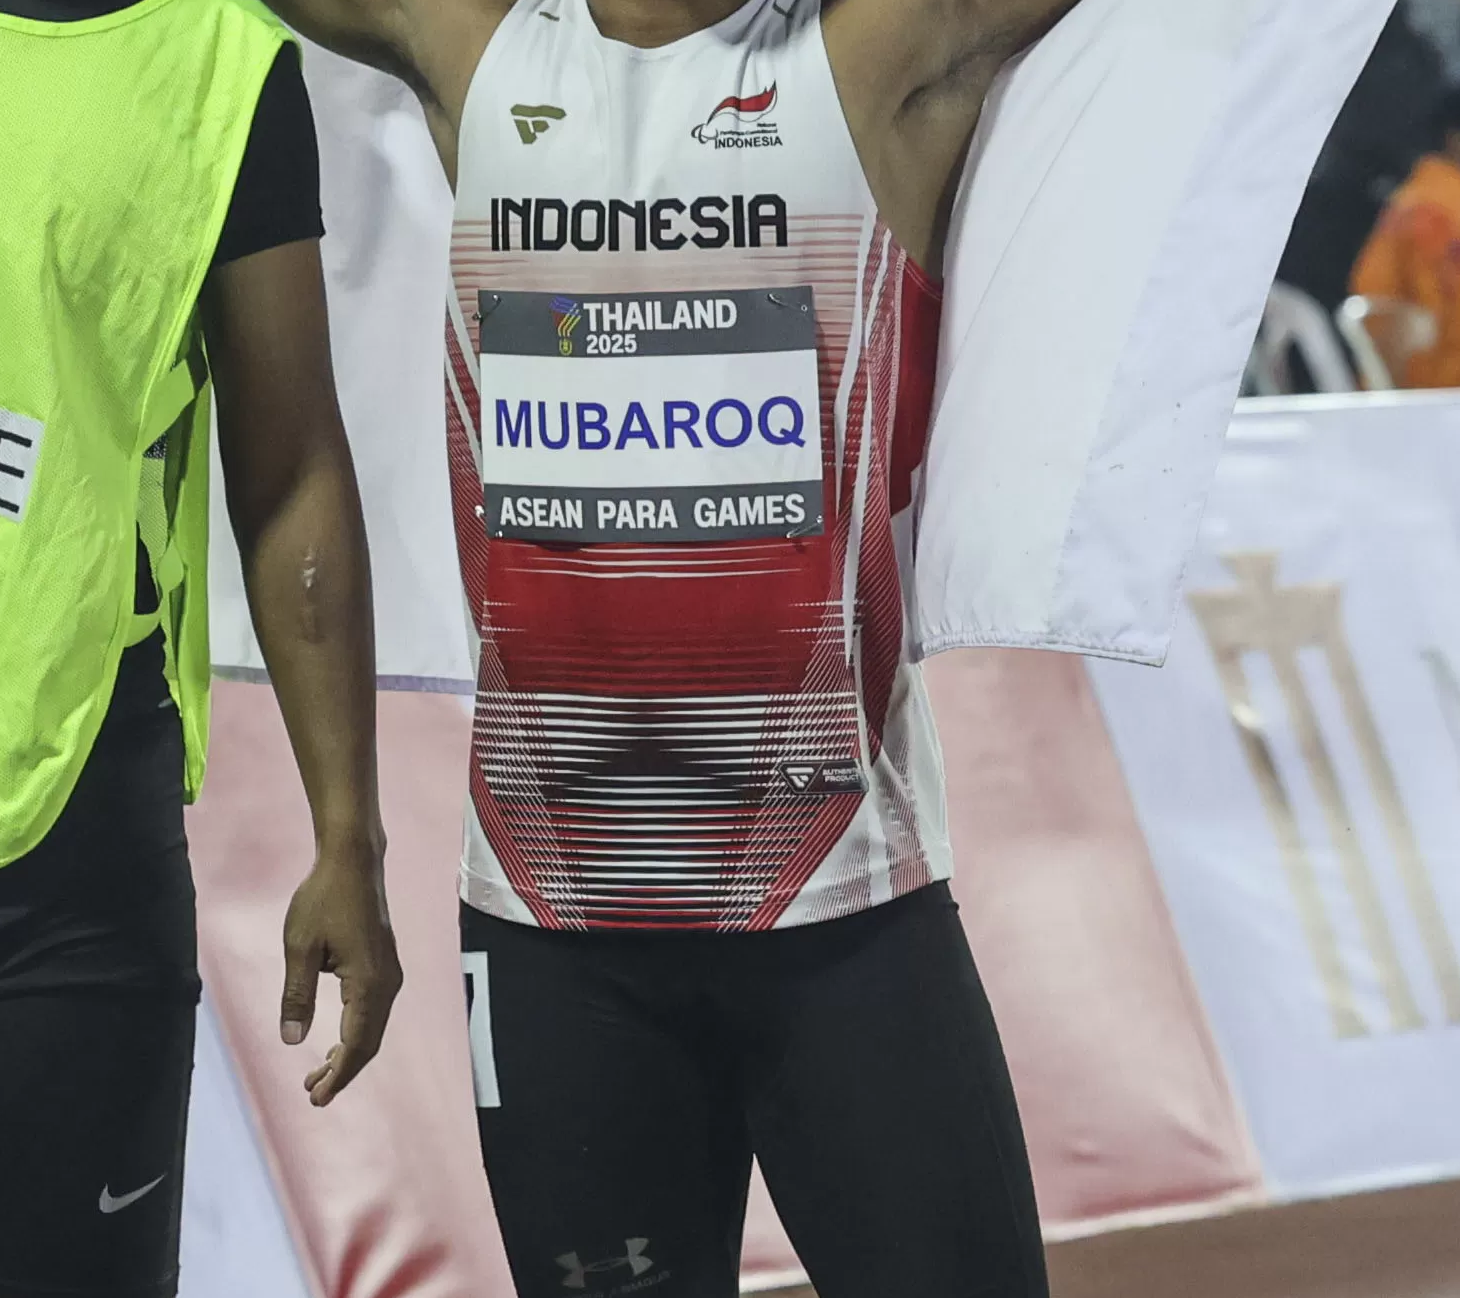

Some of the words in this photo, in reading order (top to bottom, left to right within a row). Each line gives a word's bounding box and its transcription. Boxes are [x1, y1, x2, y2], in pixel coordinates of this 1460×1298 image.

[714, 135, 783, 150] INDONESIA
[490, 193, 789, 252] INDONESIA
[583, 299, 738, 332] THAILAND
[586, 334, 638, 355] 2025
[495, 395, 806, 450] MUBAROQ
[499, 496, 584, 529] ASEAN
[597, 498, 679, 530] PARA
[693, 493, 807, 529] GAMES
